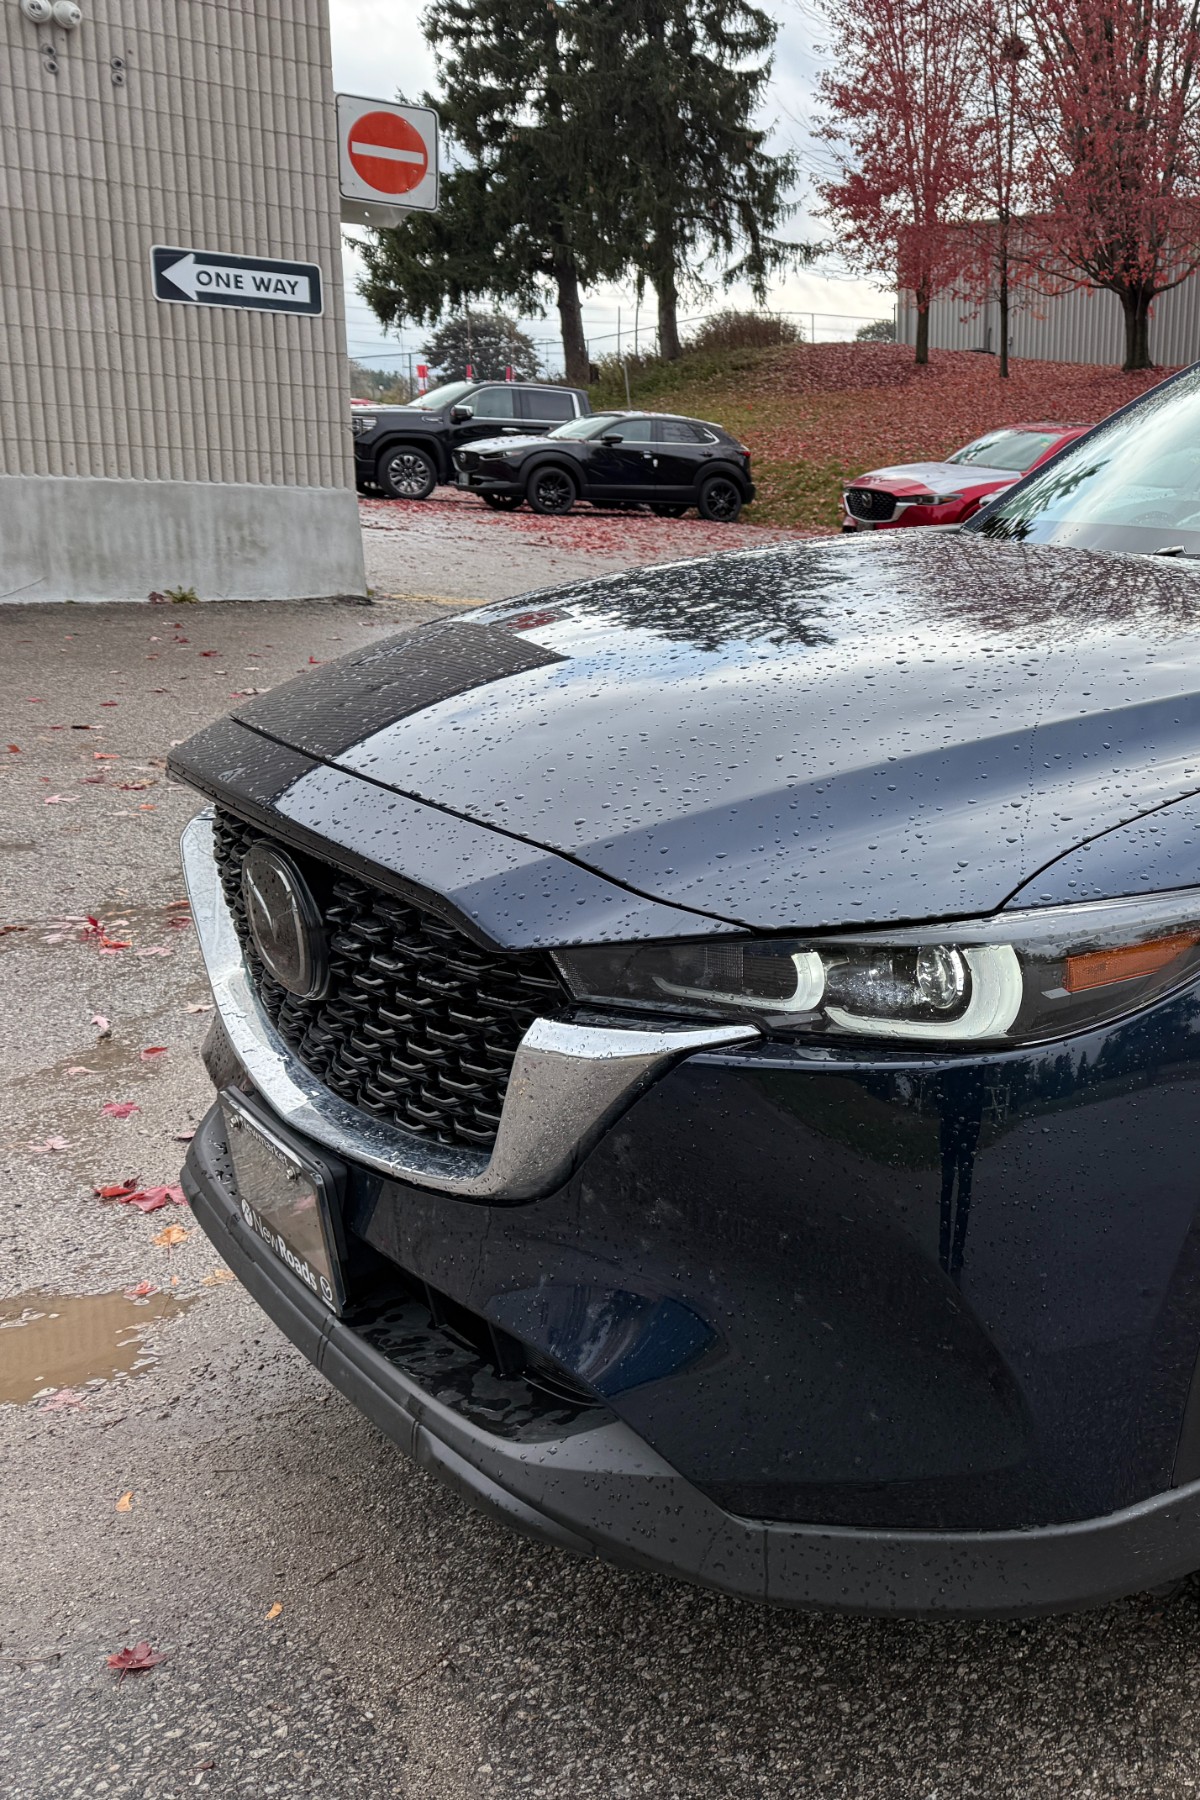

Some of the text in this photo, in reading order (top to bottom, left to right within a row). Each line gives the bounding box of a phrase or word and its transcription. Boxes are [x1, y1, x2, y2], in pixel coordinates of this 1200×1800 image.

[196, 270, 298, 295] ONE WAY
[252, 1210, 317, 1291] NewRoads
